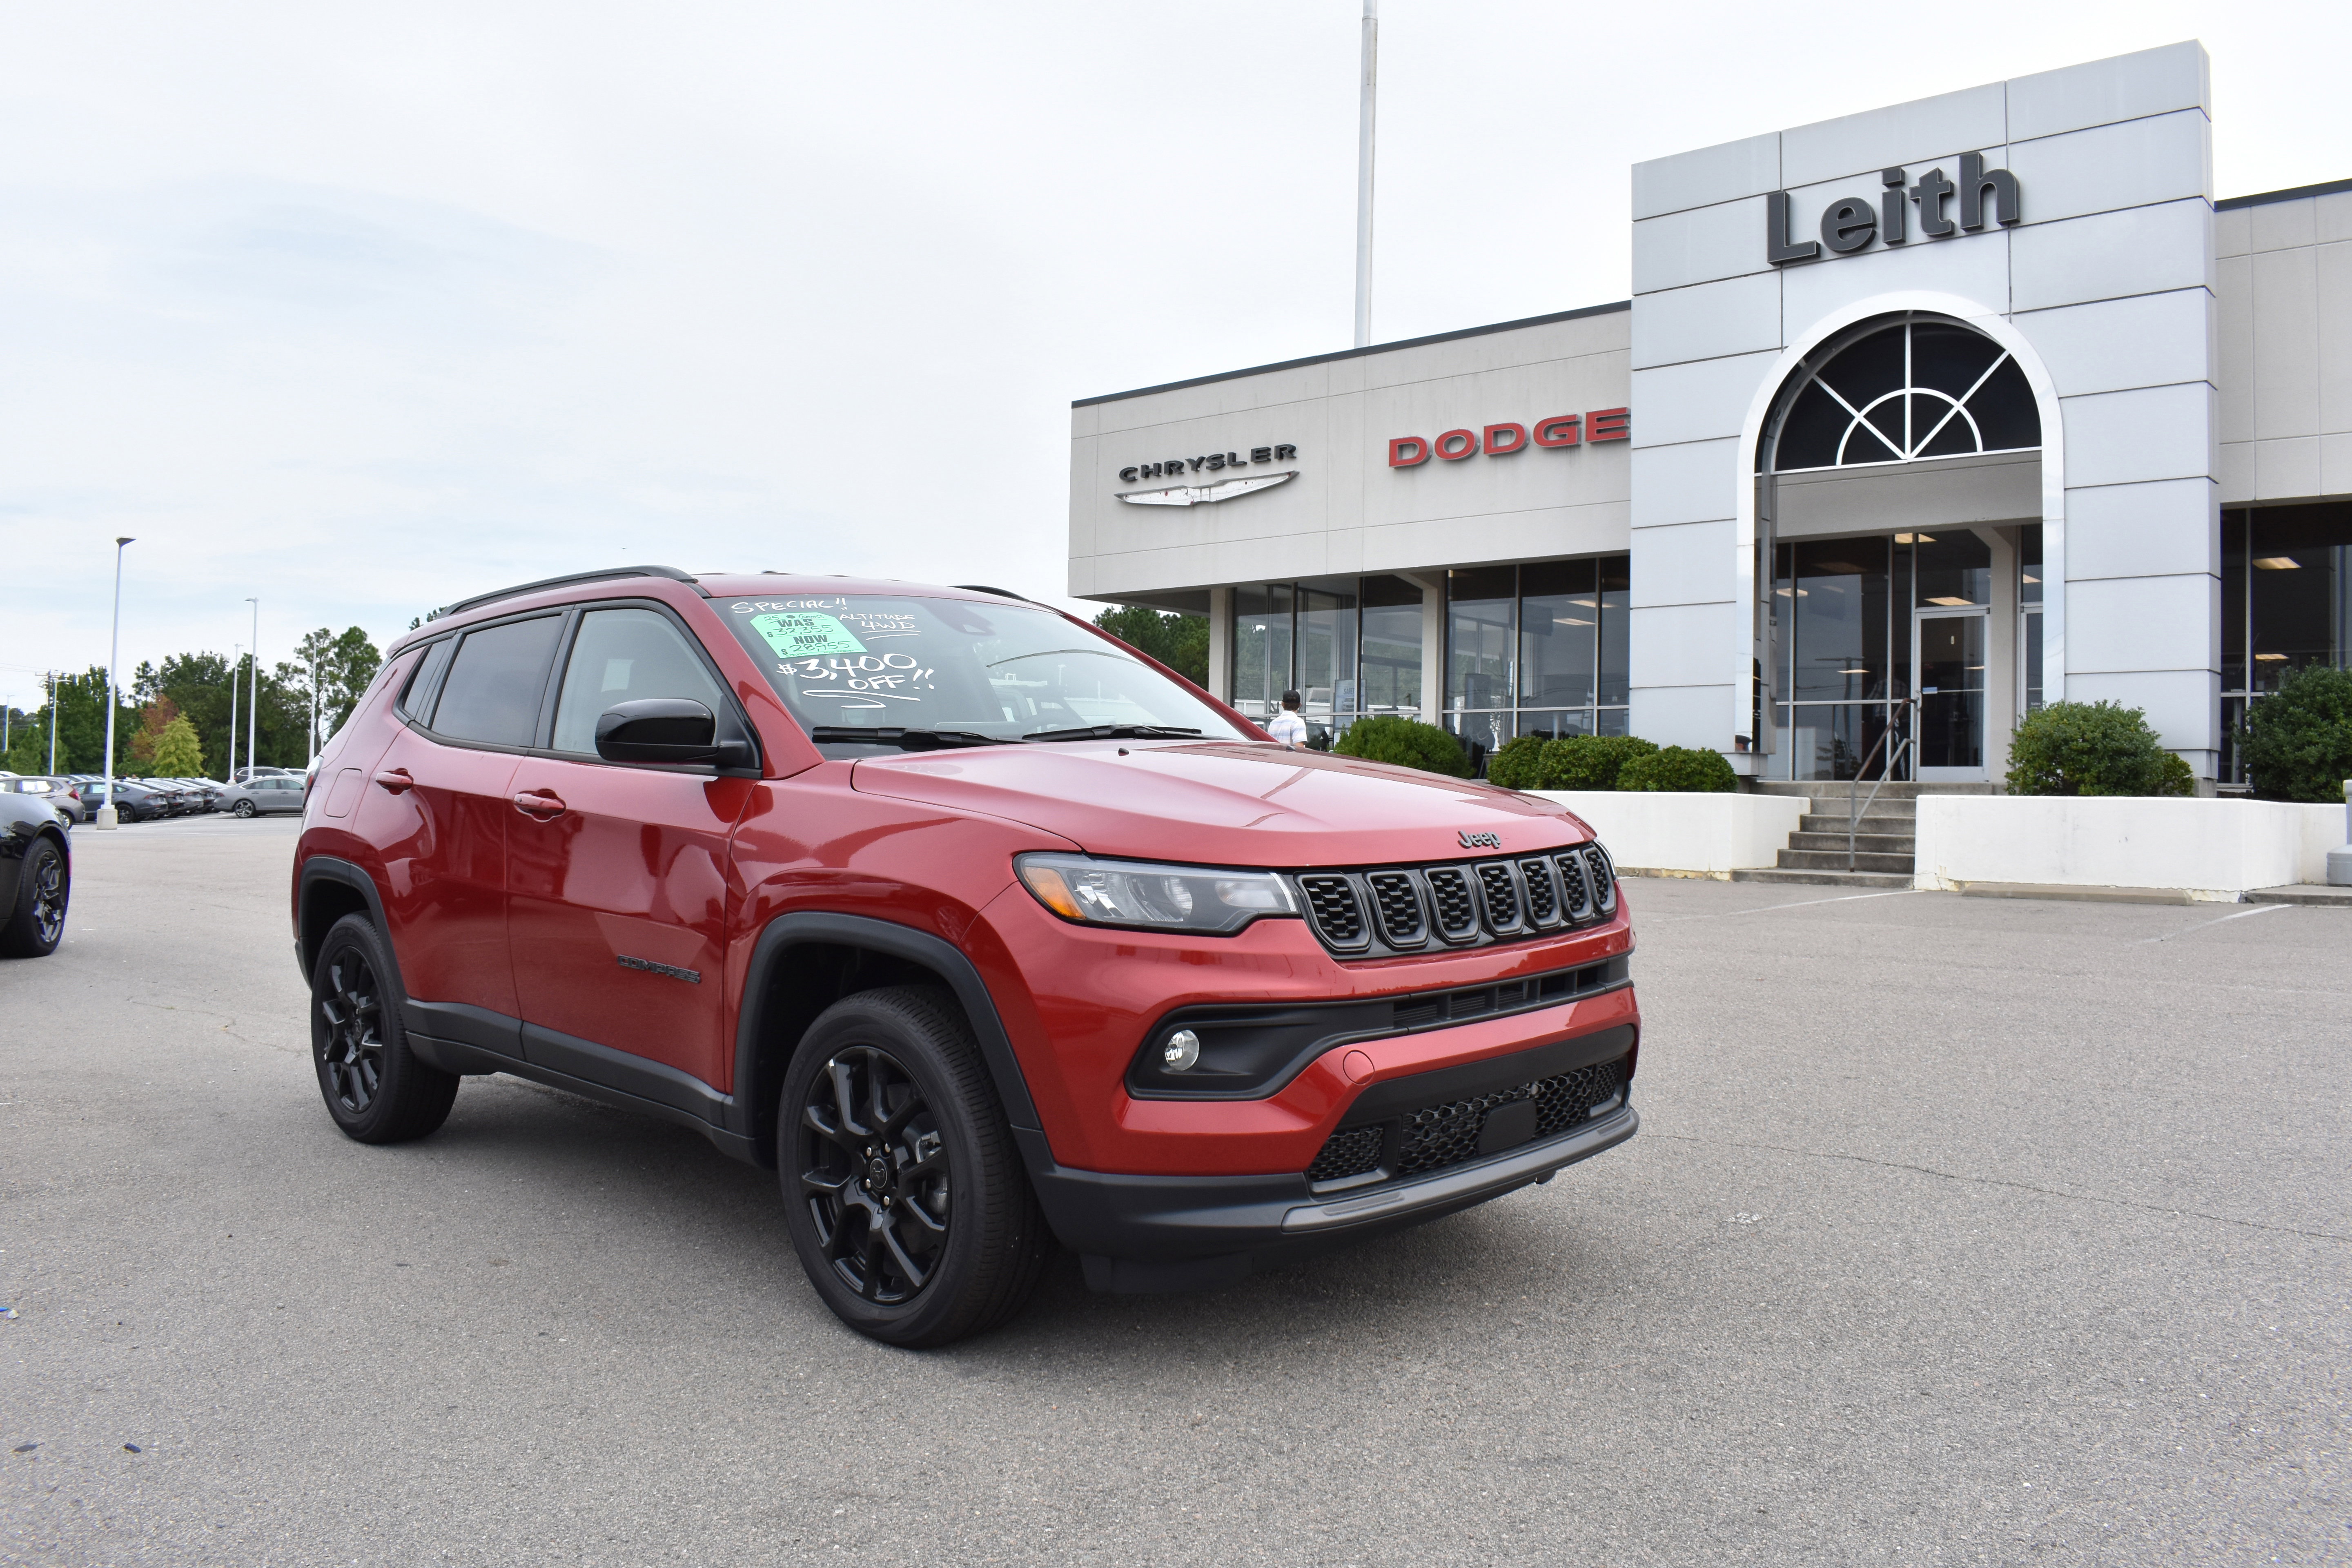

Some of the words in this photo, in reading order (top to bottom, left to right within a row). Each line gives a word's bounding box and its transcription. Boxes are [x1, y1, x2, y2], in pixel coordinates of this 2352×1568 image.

[1766, 152, 2020, 265] Leith
[1389, 407, 1631, 469] DODGE
[1119, 443, 1296, 481] CHRYSLER
[777, 619, 815, 628] WAS
[861, 620, 915, 630] 4WD
[793, 635, 828, 644] NOW
[776, 653, 917, 681] $3,400
[1457, 830, 1501, 849] Jeep
[617, 954, 701, 984] COMPASS
